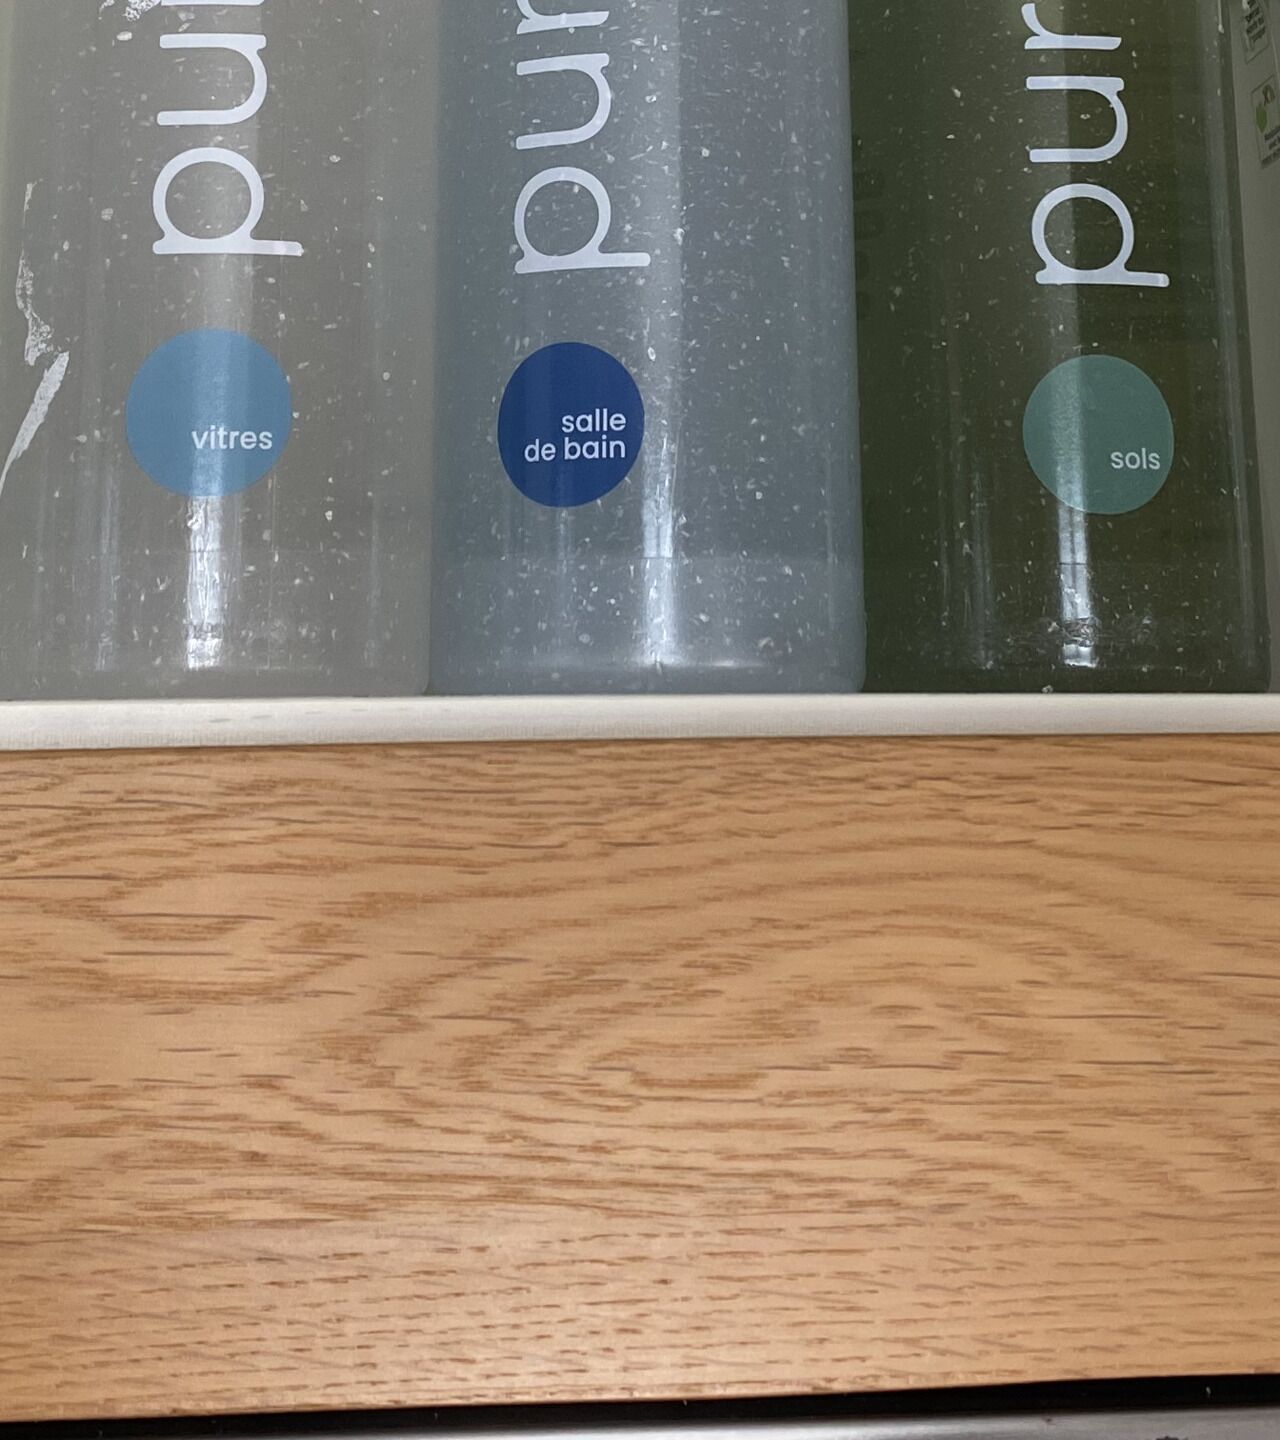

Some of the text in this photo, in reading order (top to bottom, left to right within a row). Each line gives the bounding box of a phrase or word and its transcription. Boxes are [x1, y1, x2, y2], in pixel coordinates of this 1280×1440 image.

[561, 408, 627, 434] salle
[191, 424, 274, 451] vitres
[524, 435, 627, 462] de bain
[1110, 446, 1162, 471] sols
